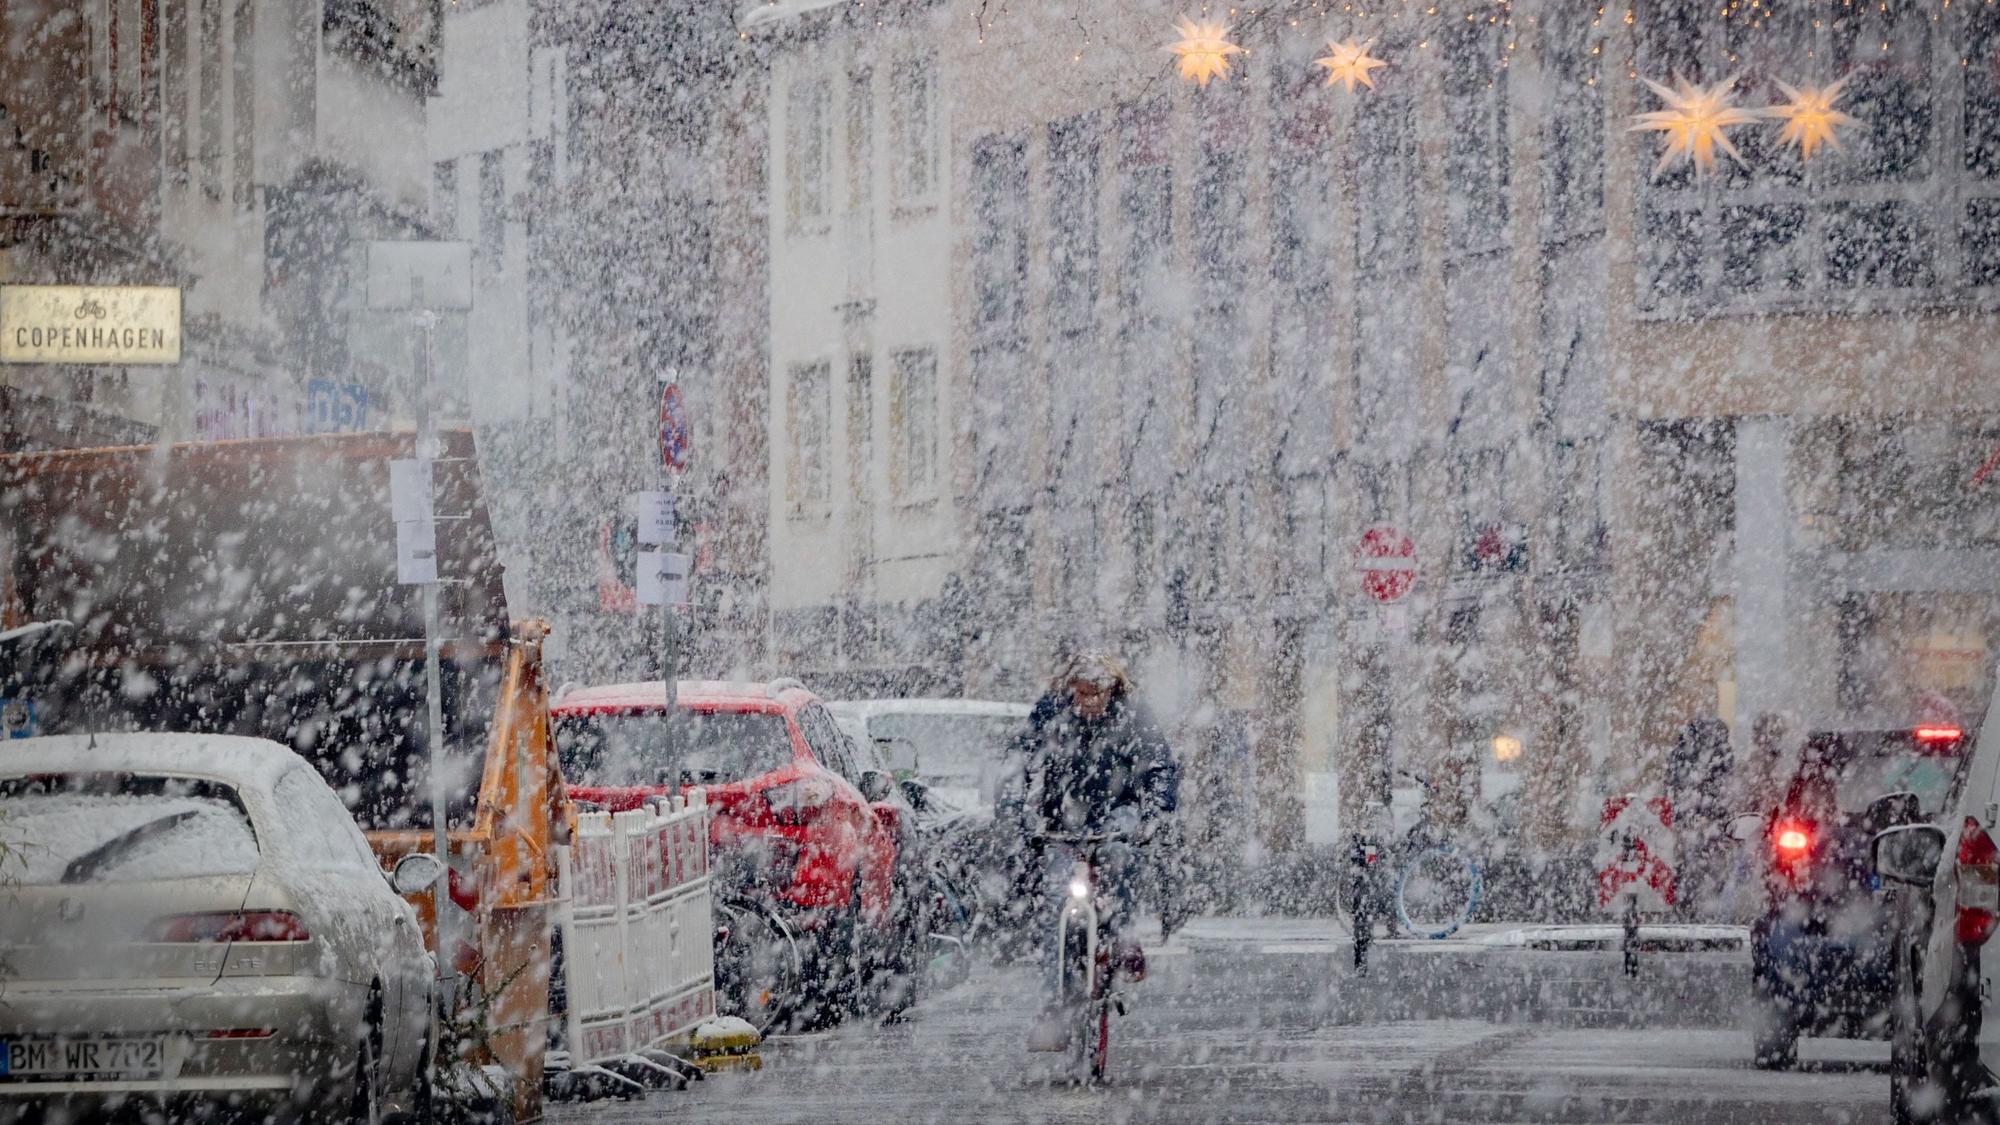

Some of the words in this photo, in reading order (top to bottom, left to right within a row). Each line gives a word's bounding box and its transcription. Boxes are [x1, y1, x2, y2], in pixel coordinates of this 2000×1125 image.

[16, 327, 164, 349] COPENHAGEN
[10, 1043, 46, 1070] BM
[66, 1042, 100, 1069] WR
